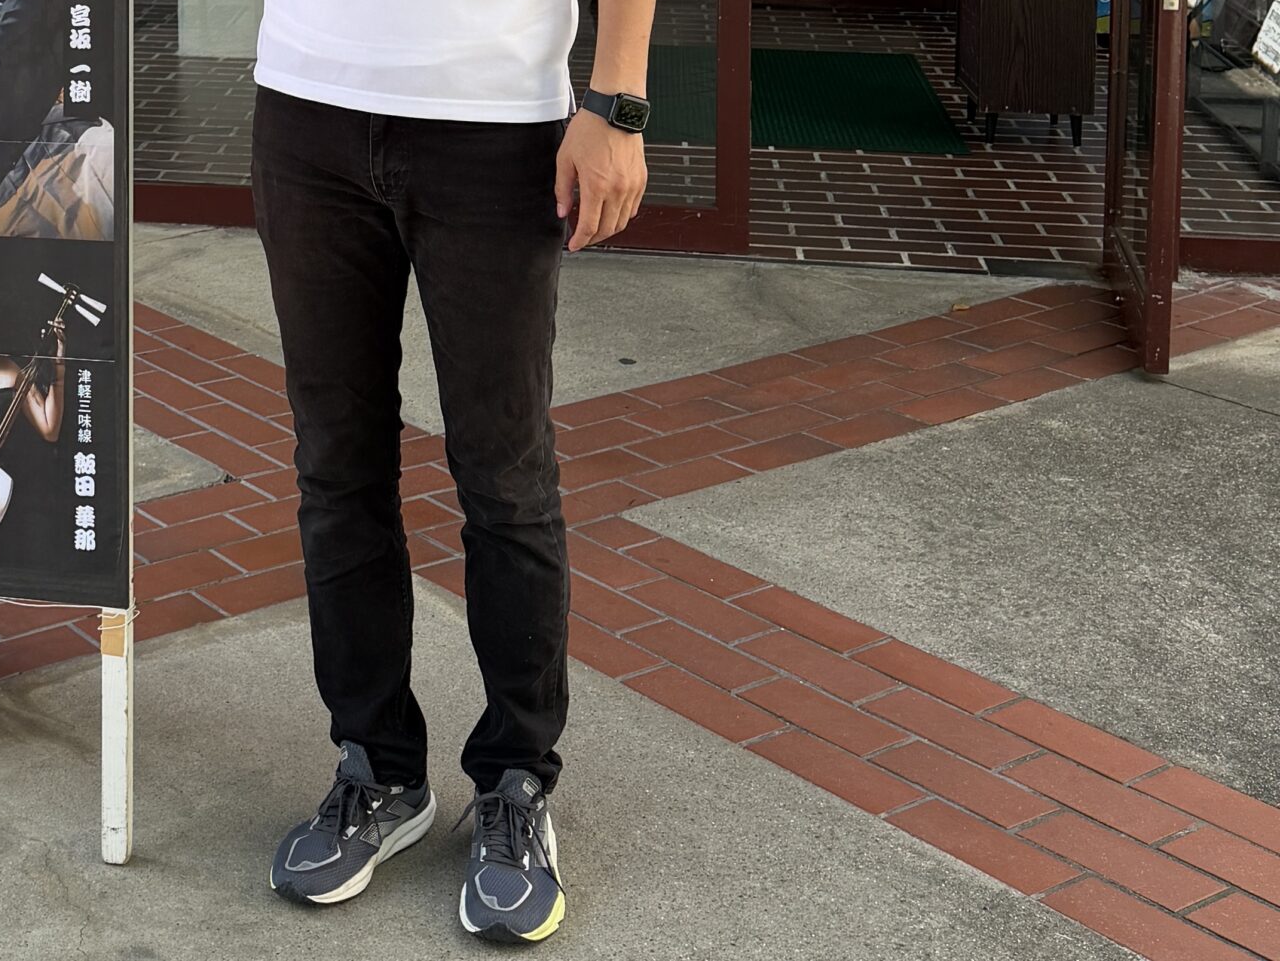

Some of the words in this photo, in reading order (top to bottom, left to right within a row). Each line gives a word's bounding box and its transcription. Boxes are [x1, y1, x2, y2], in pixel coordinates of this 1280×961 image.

[77, 368, 93, 443] 津軽三味線
